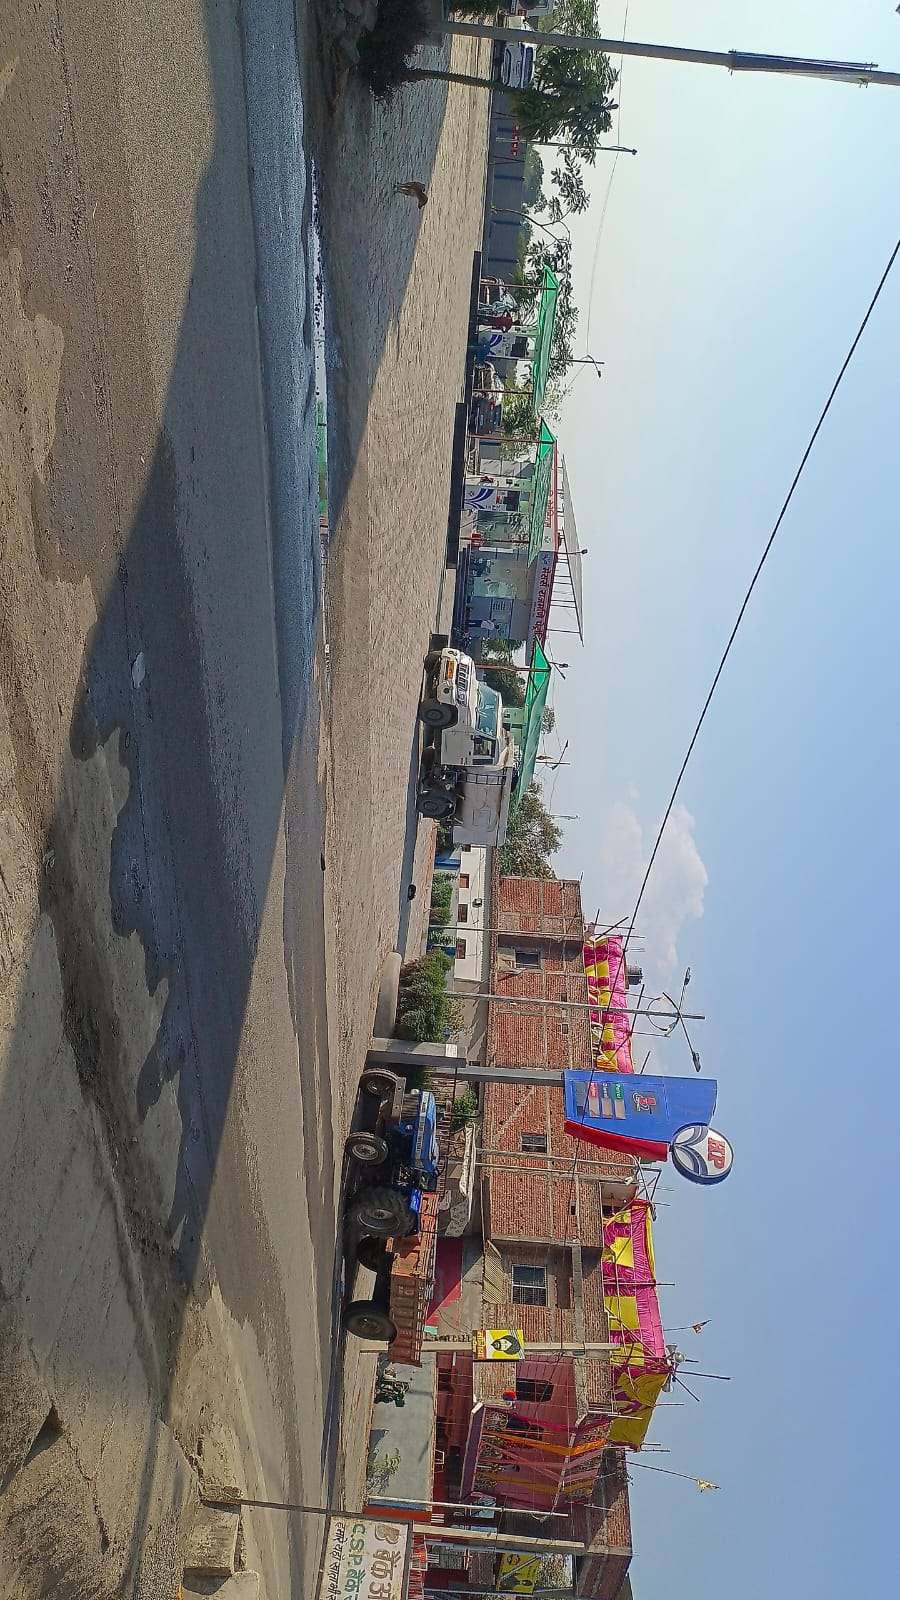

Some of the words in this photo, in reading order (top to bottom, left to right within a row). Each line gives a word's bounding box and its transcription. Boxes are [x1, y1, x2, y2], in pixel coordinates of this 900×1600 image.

[708, 1138, 725, 1169] HP
[348, 1524, 366, 1565] C.S.P.
[344, 1568, 366, 1592] बैंक
[370, 1550, 402, 1580] बैंक
